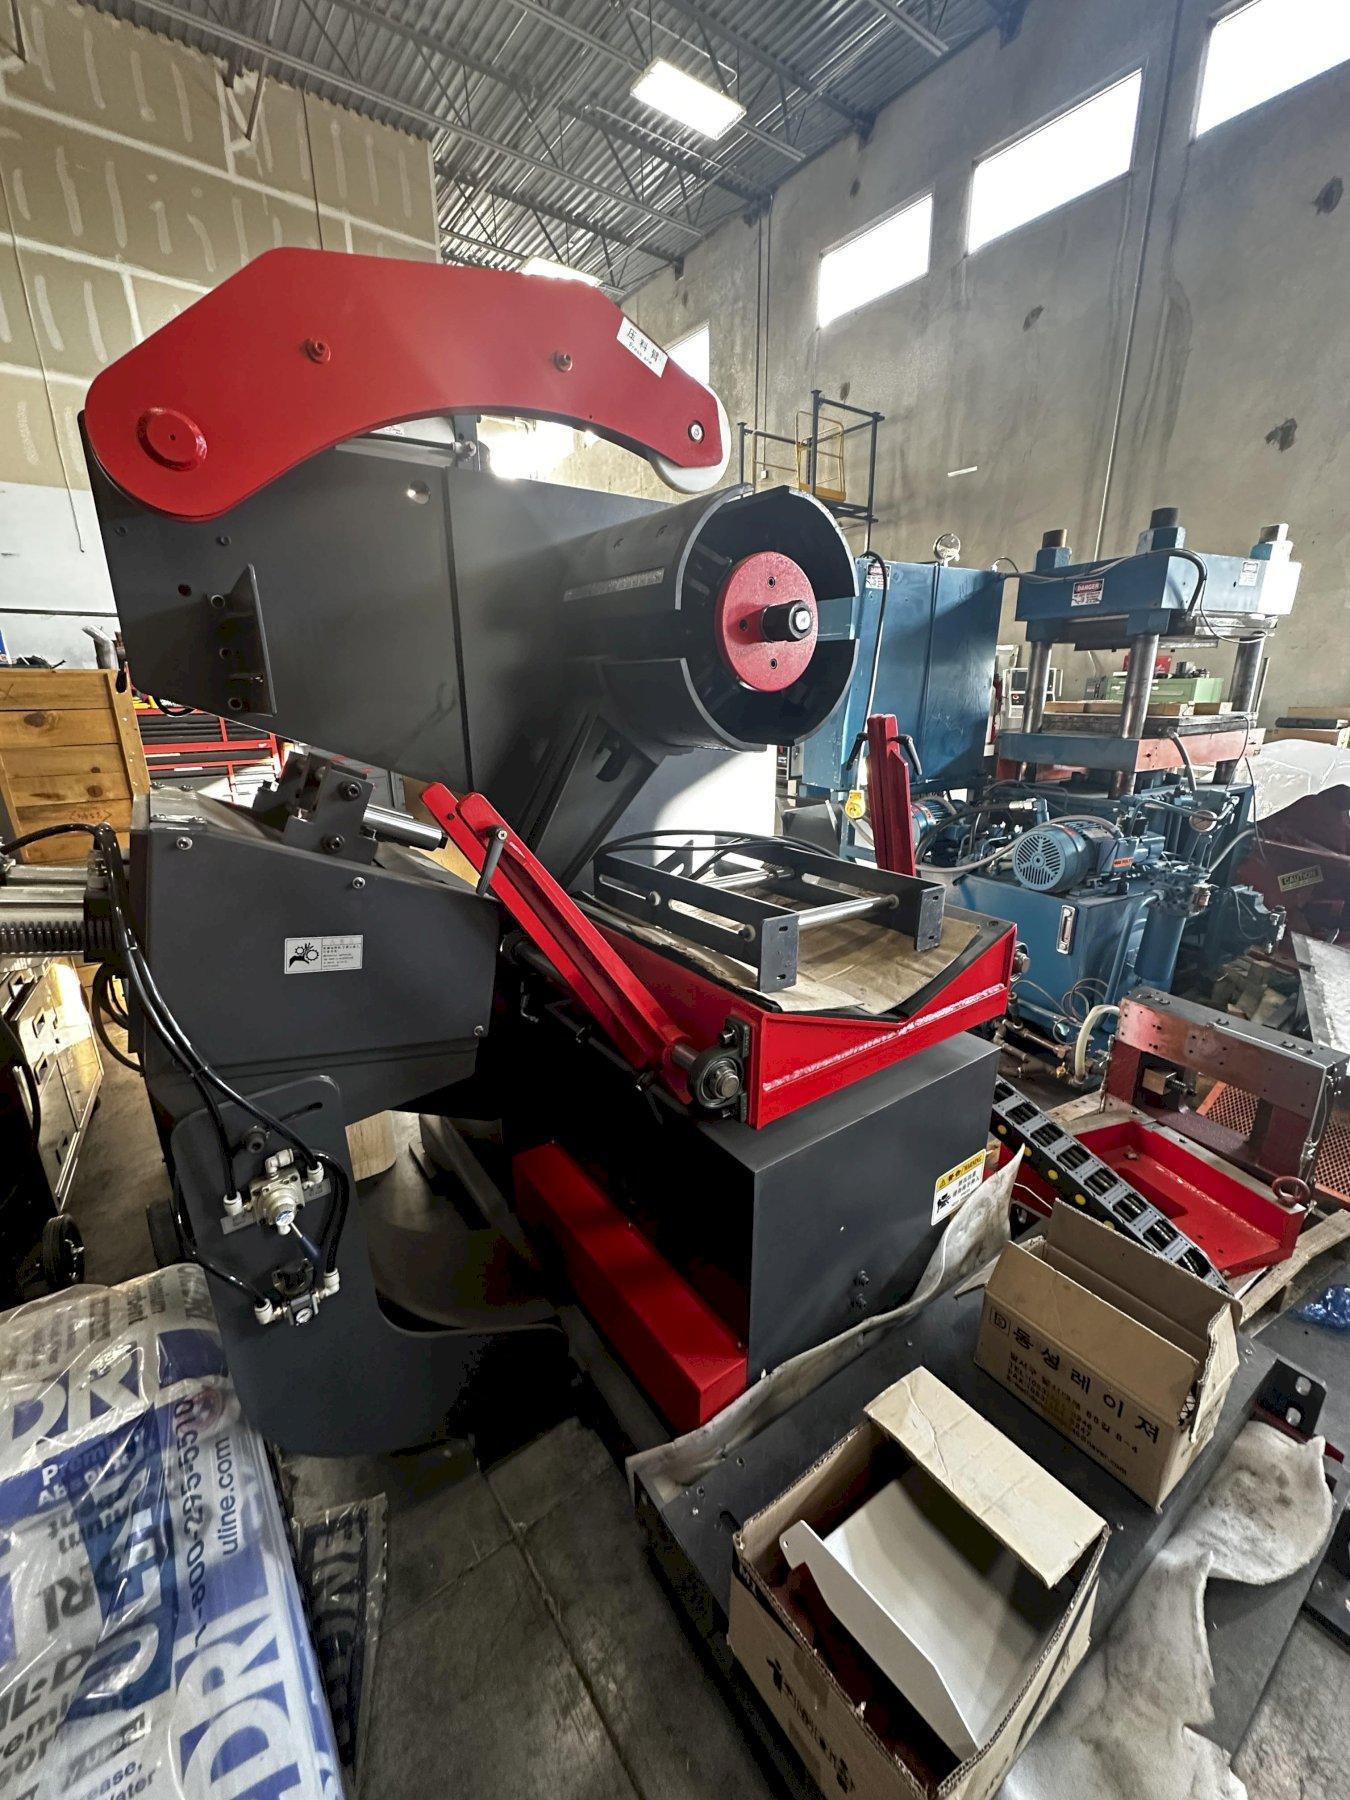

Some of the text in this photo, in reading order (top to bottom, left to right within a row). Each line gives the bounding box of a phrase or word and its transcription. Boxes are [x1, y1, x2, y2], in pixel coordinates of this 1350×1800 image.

[1077, 582, 1101, 593] DANGER
[1282, 870, 1318, 885] CAUTION
[174, 1397, 211, 1646] 1-800-295-5510
[215, 1437, 239, 1555] uline.com
